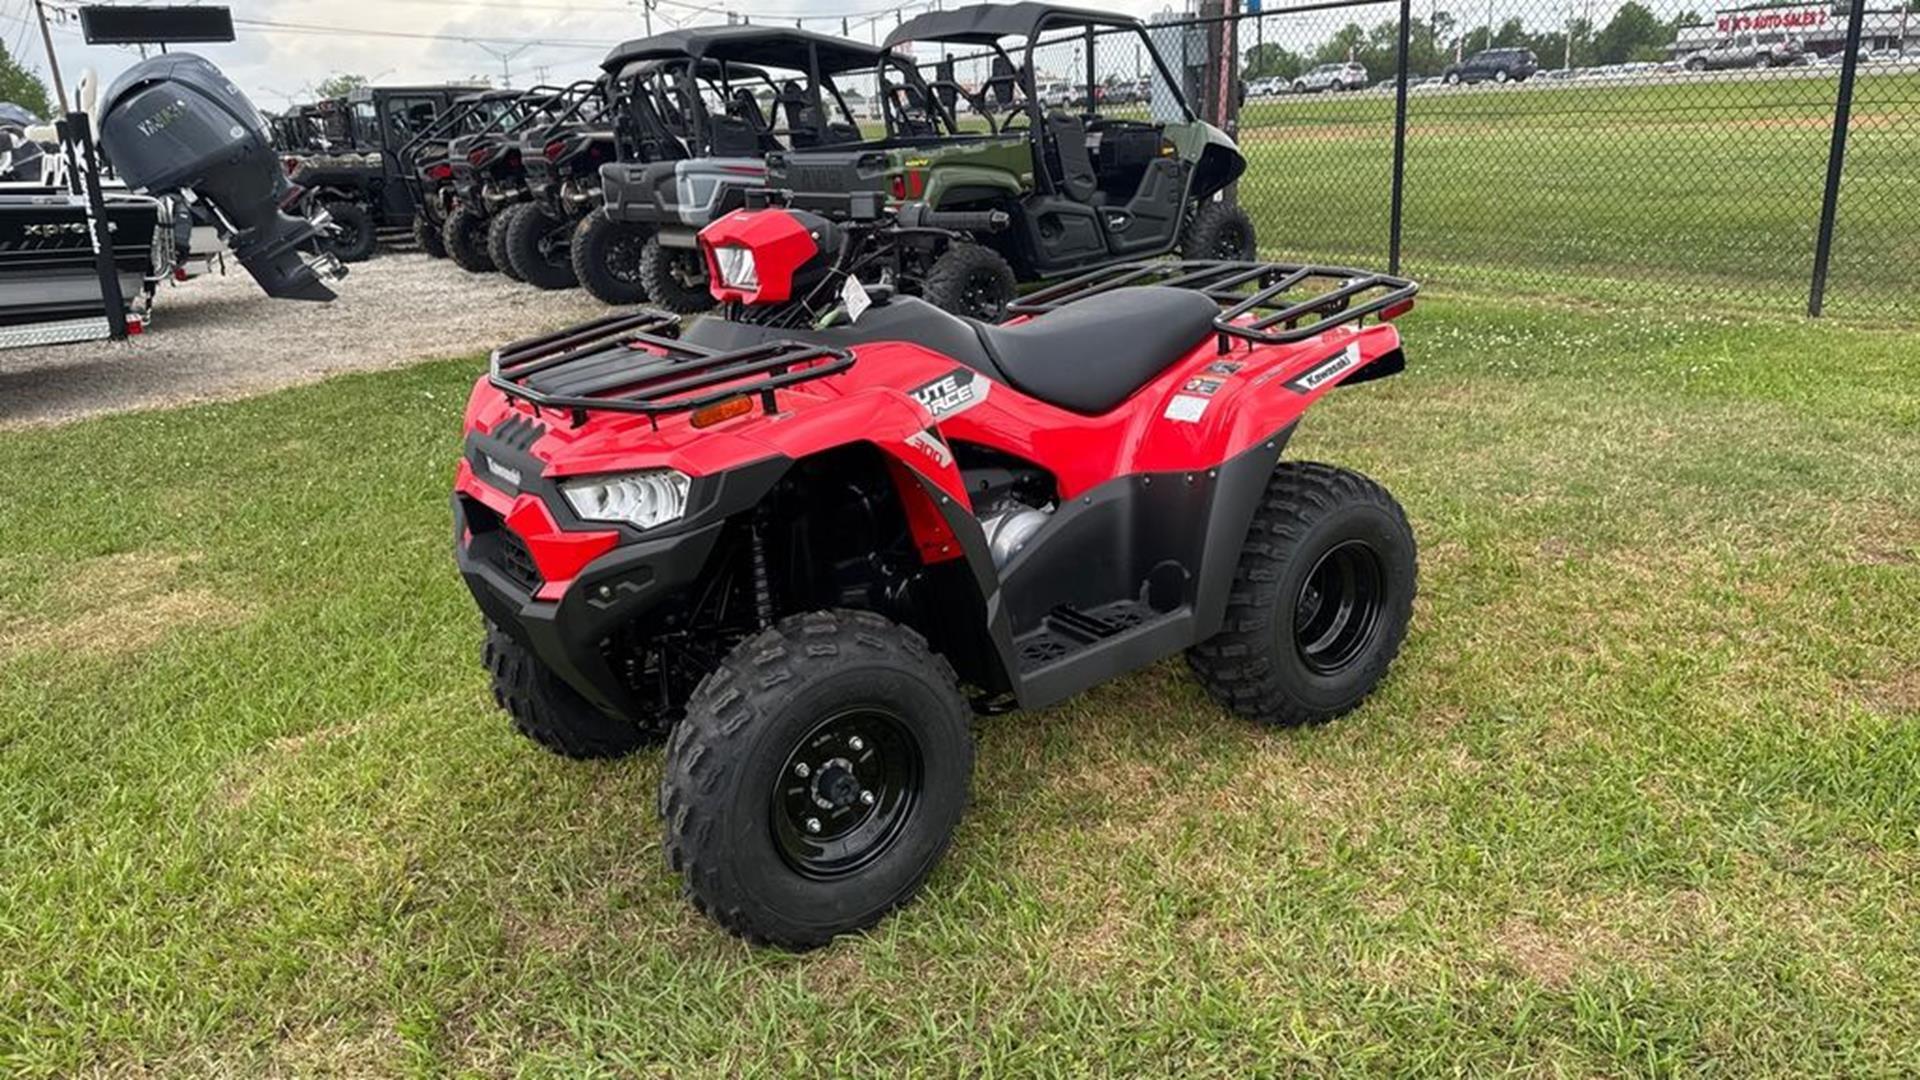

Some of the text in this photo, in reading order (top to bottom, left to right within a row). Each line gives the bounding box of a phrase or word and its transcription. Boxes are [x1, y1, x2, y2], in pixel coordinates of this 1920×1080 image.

[1306, 355, 1352, 387] Kawasaki
[909, 374, 958, 407] UTE
[927, 382, 974, 416] RCE
